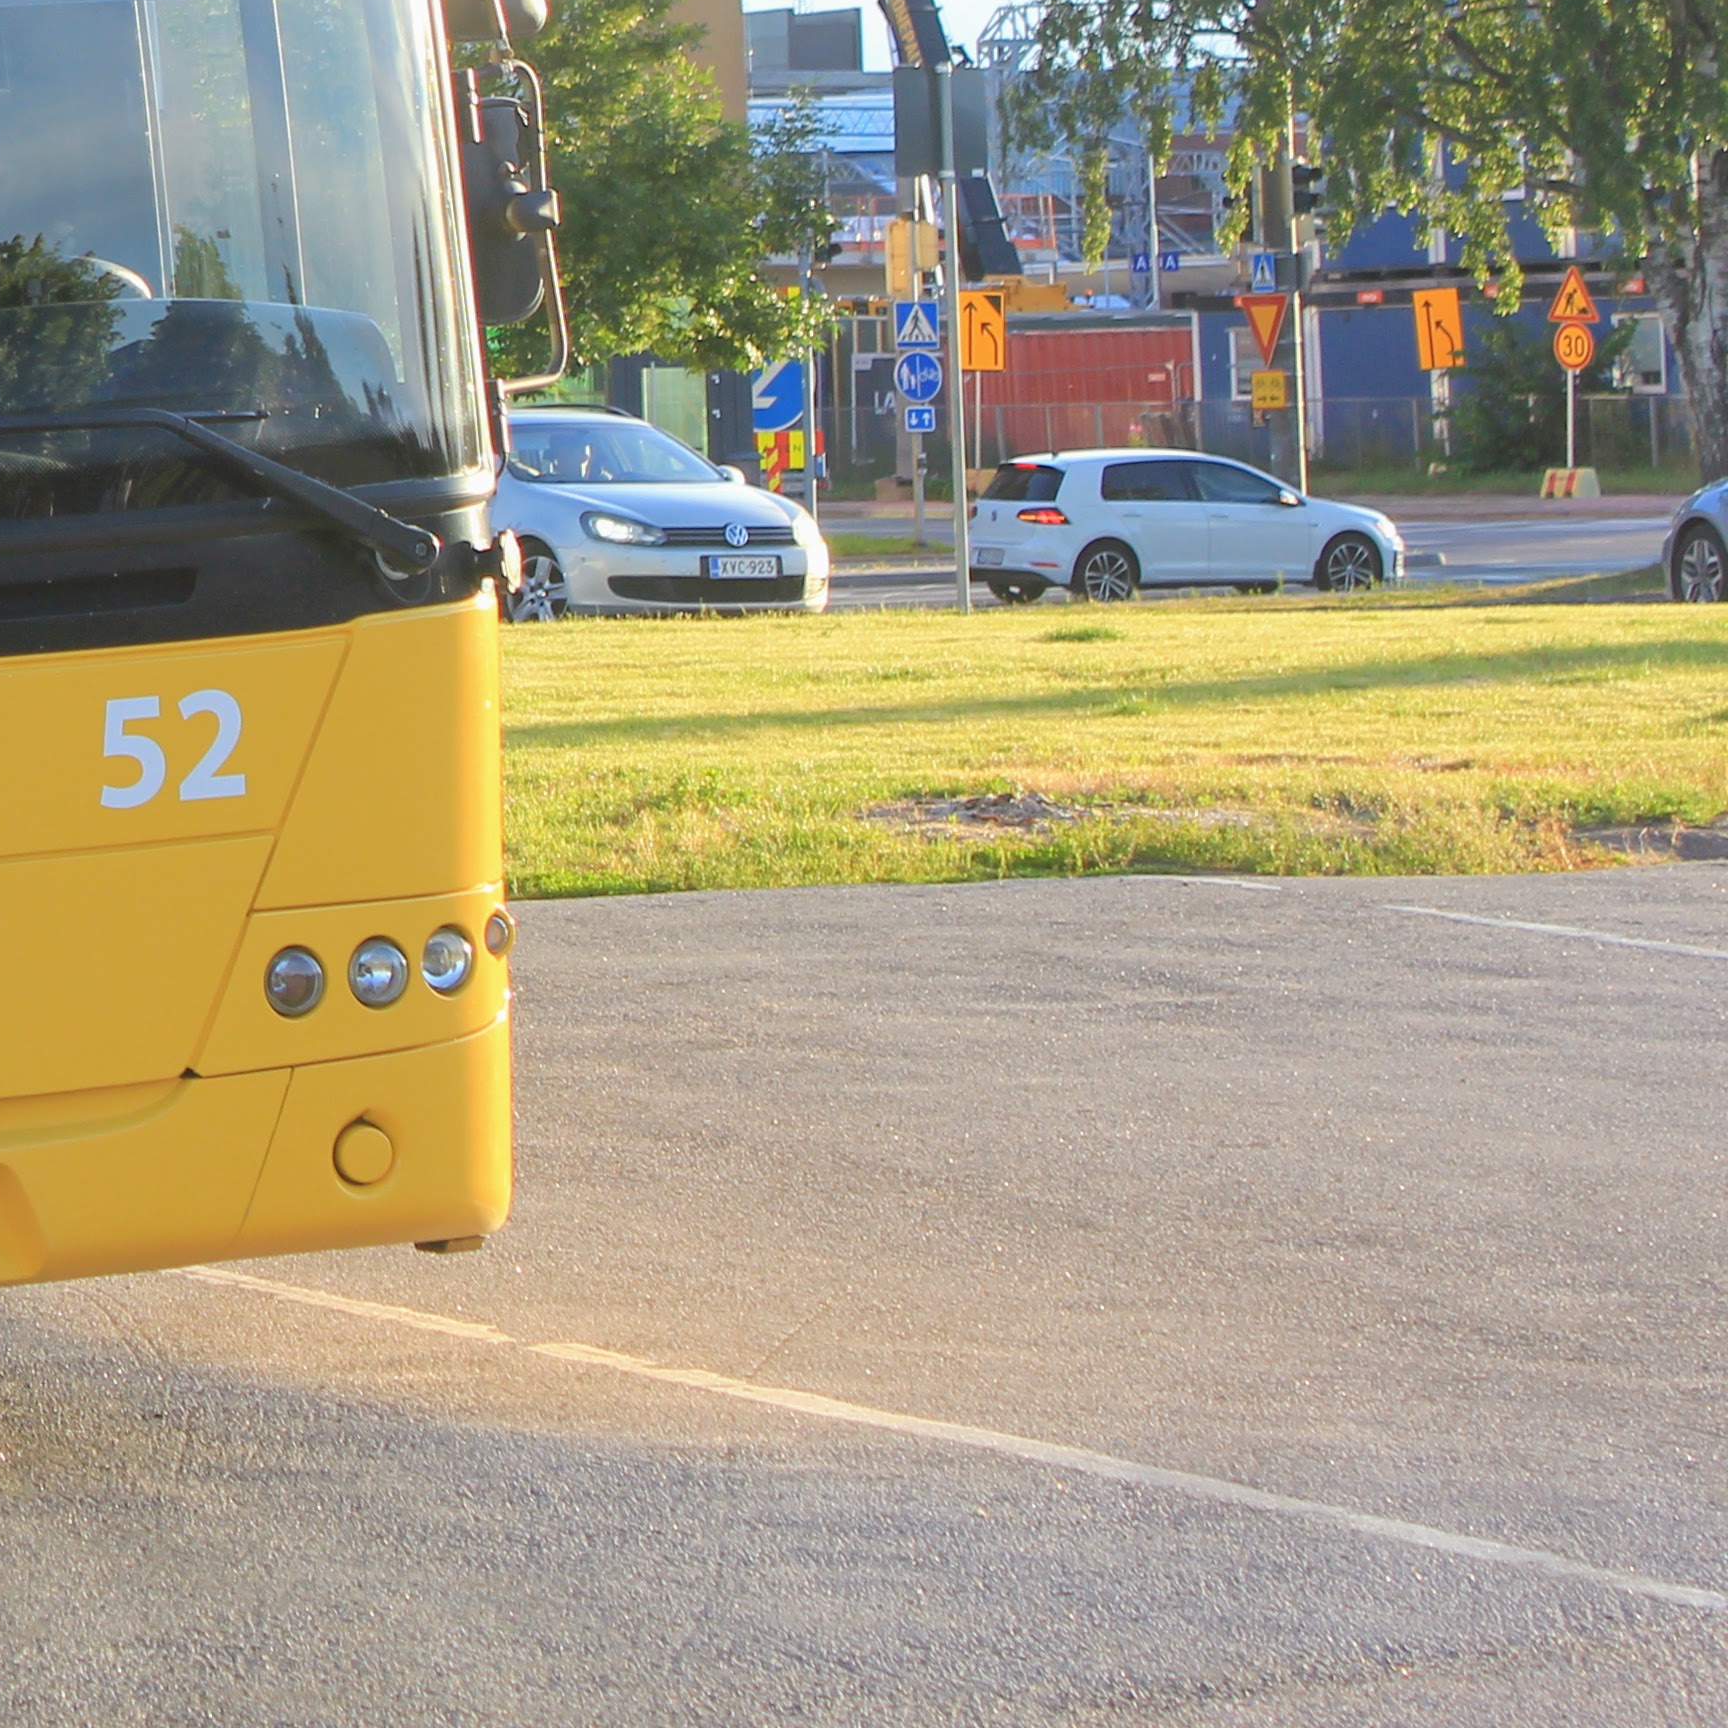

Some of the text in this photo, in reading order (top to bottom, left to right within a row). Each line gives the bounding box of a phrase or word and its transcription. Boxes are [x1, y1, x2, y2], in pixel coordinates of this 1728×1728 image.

[1562, 335, 1585, 358] 30
[721, 559, 775, 575] XVC-923
[100, 689, 248, 810] 52
